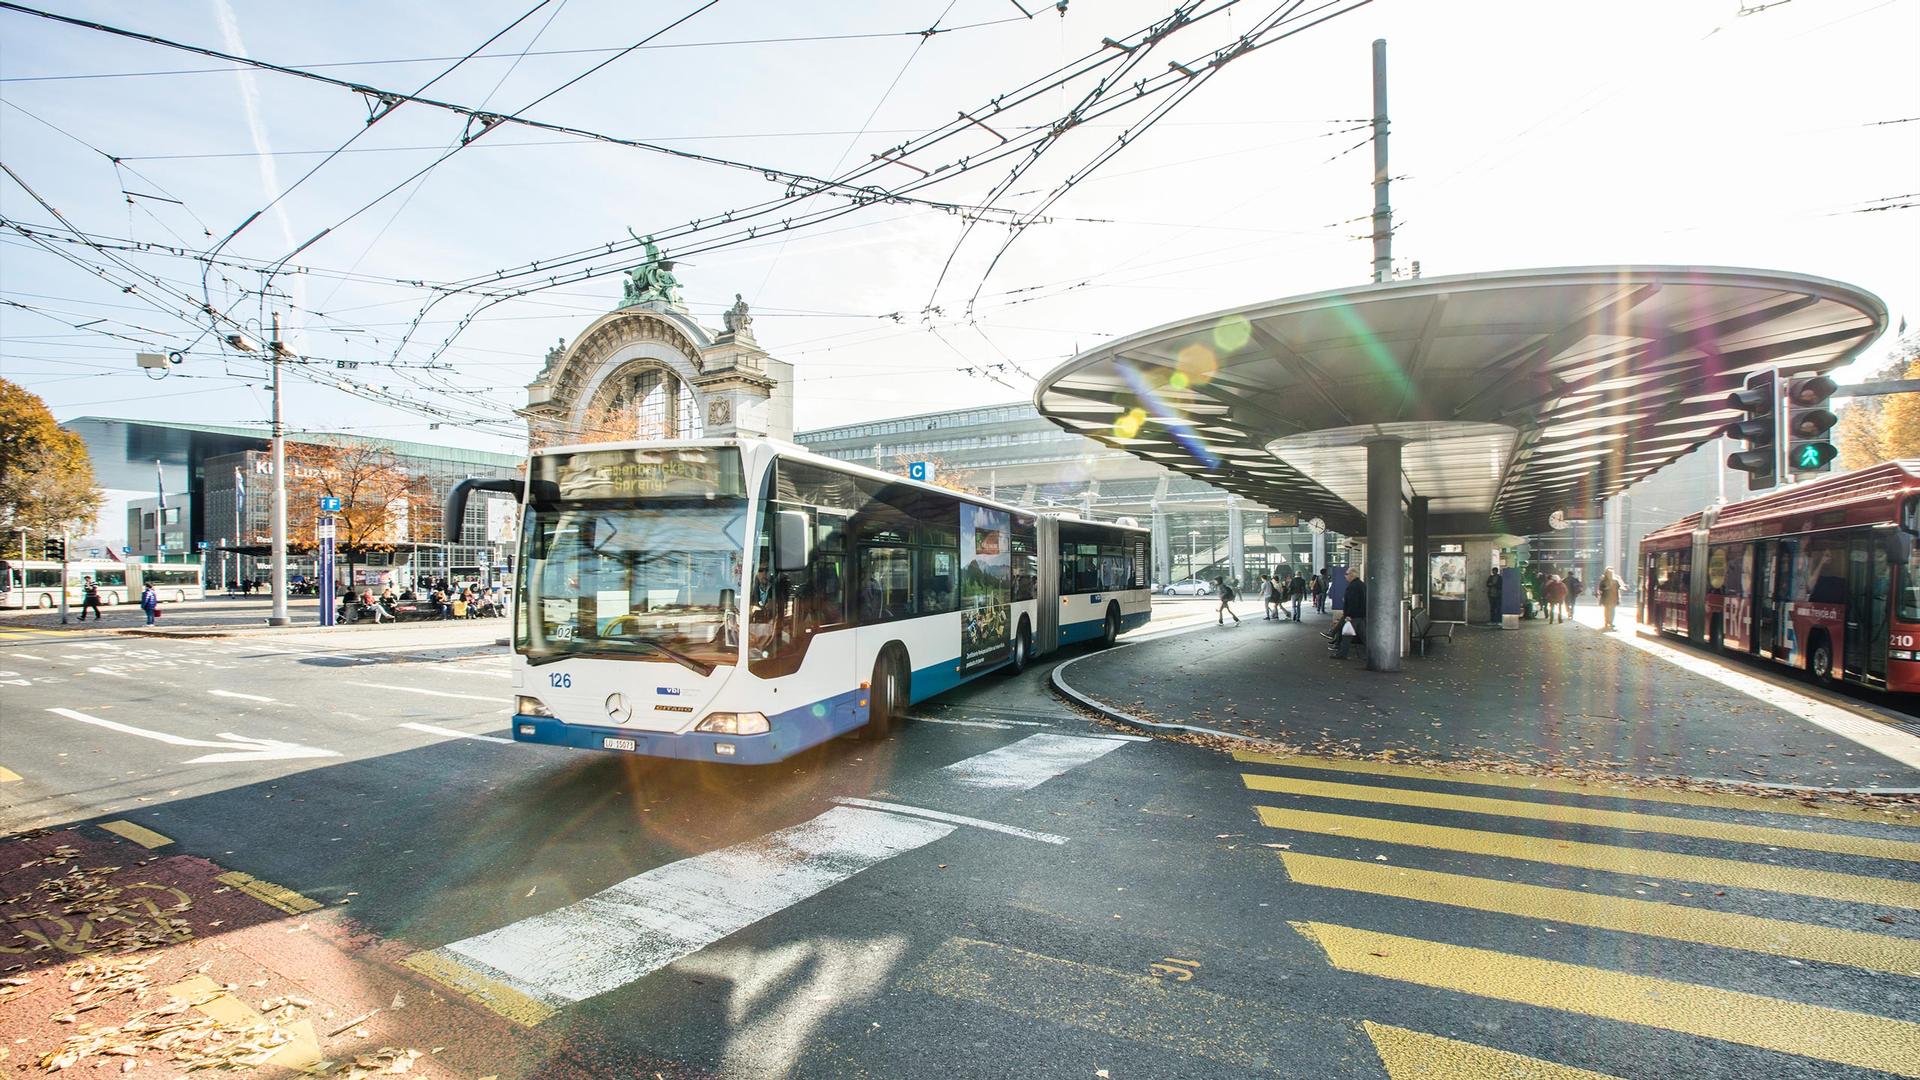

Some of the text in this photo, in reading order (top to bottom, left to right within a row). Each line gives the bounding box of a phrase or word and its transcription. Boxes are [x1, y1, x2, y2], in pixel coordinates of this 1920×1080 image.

[912, 465, 922, 478] C
[329, 500, 338, 509] F
[557, 626, 572, 639] 02
[1889, 634, 1914, 647] 210
[549, 672, 572, 688] 126
